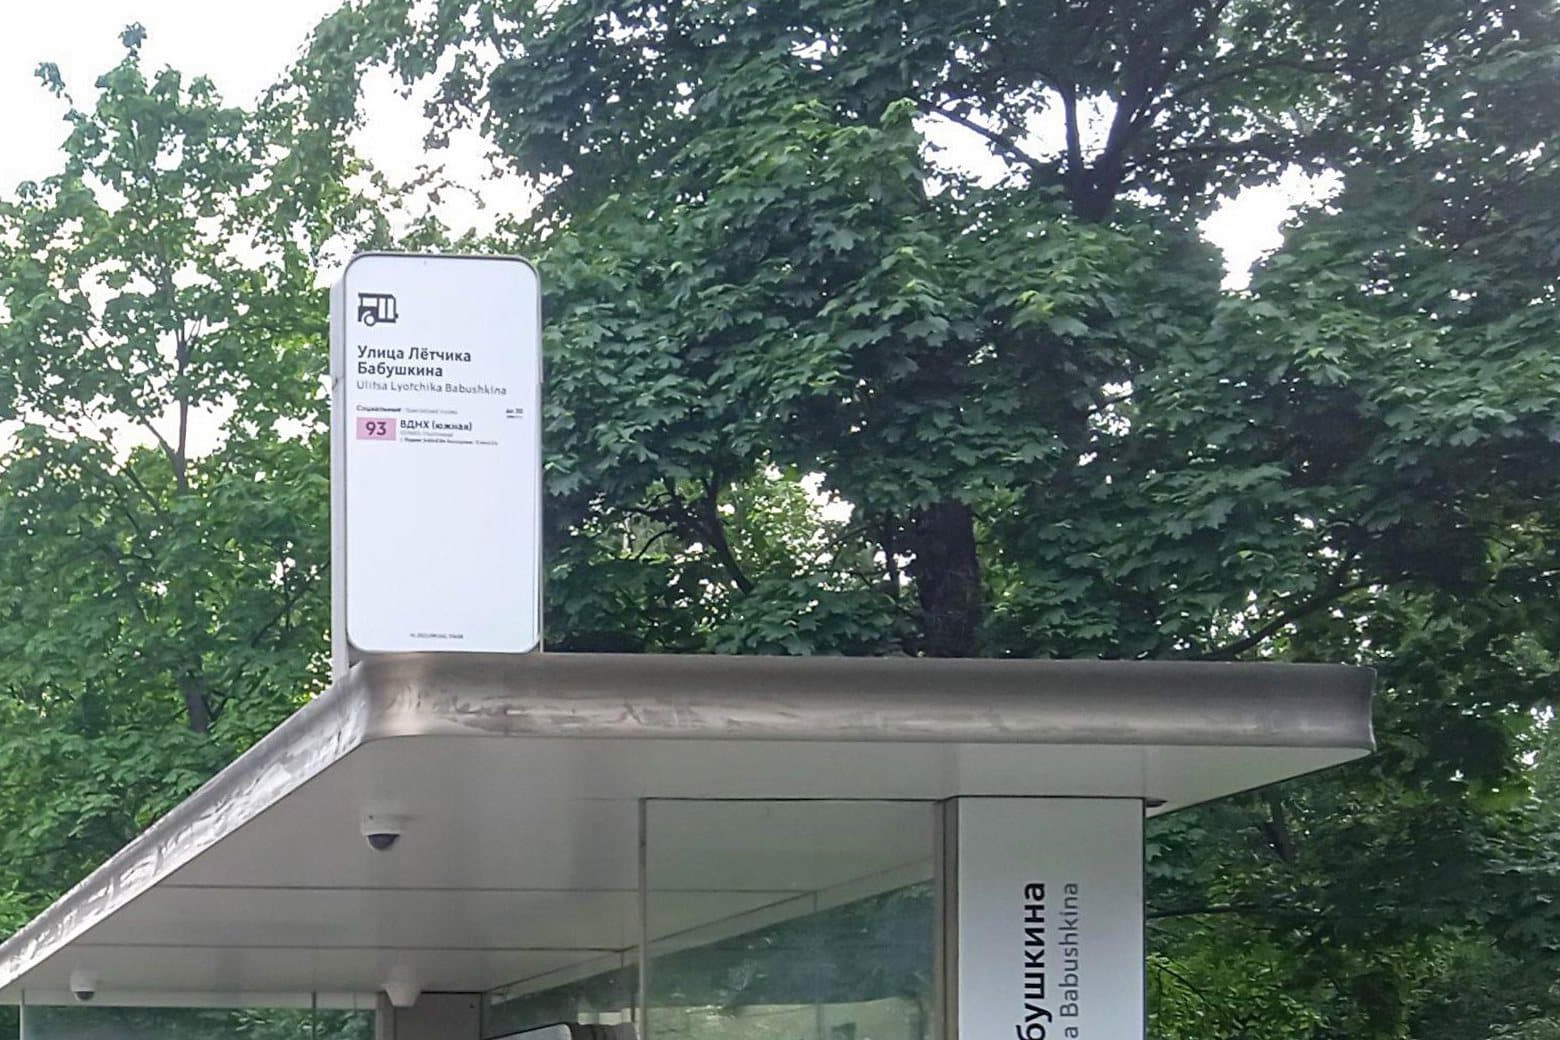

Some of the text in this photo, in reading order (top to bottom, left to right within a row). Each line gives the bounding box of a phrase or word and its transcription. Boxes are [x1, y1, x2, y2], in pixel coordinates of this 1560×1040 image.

[357, 345, 472, 362] Улица Лётчика
[357, 362, 443, 378] Бабушкина
[356, 380, 507, 395] Ulitsa Lyotchika Babushkina
[365, 421, 387, 436] 93
[400, 419, 473, 431] ВДНХ (южная)
[1058, 883, 1079, 1017] Babushkina
